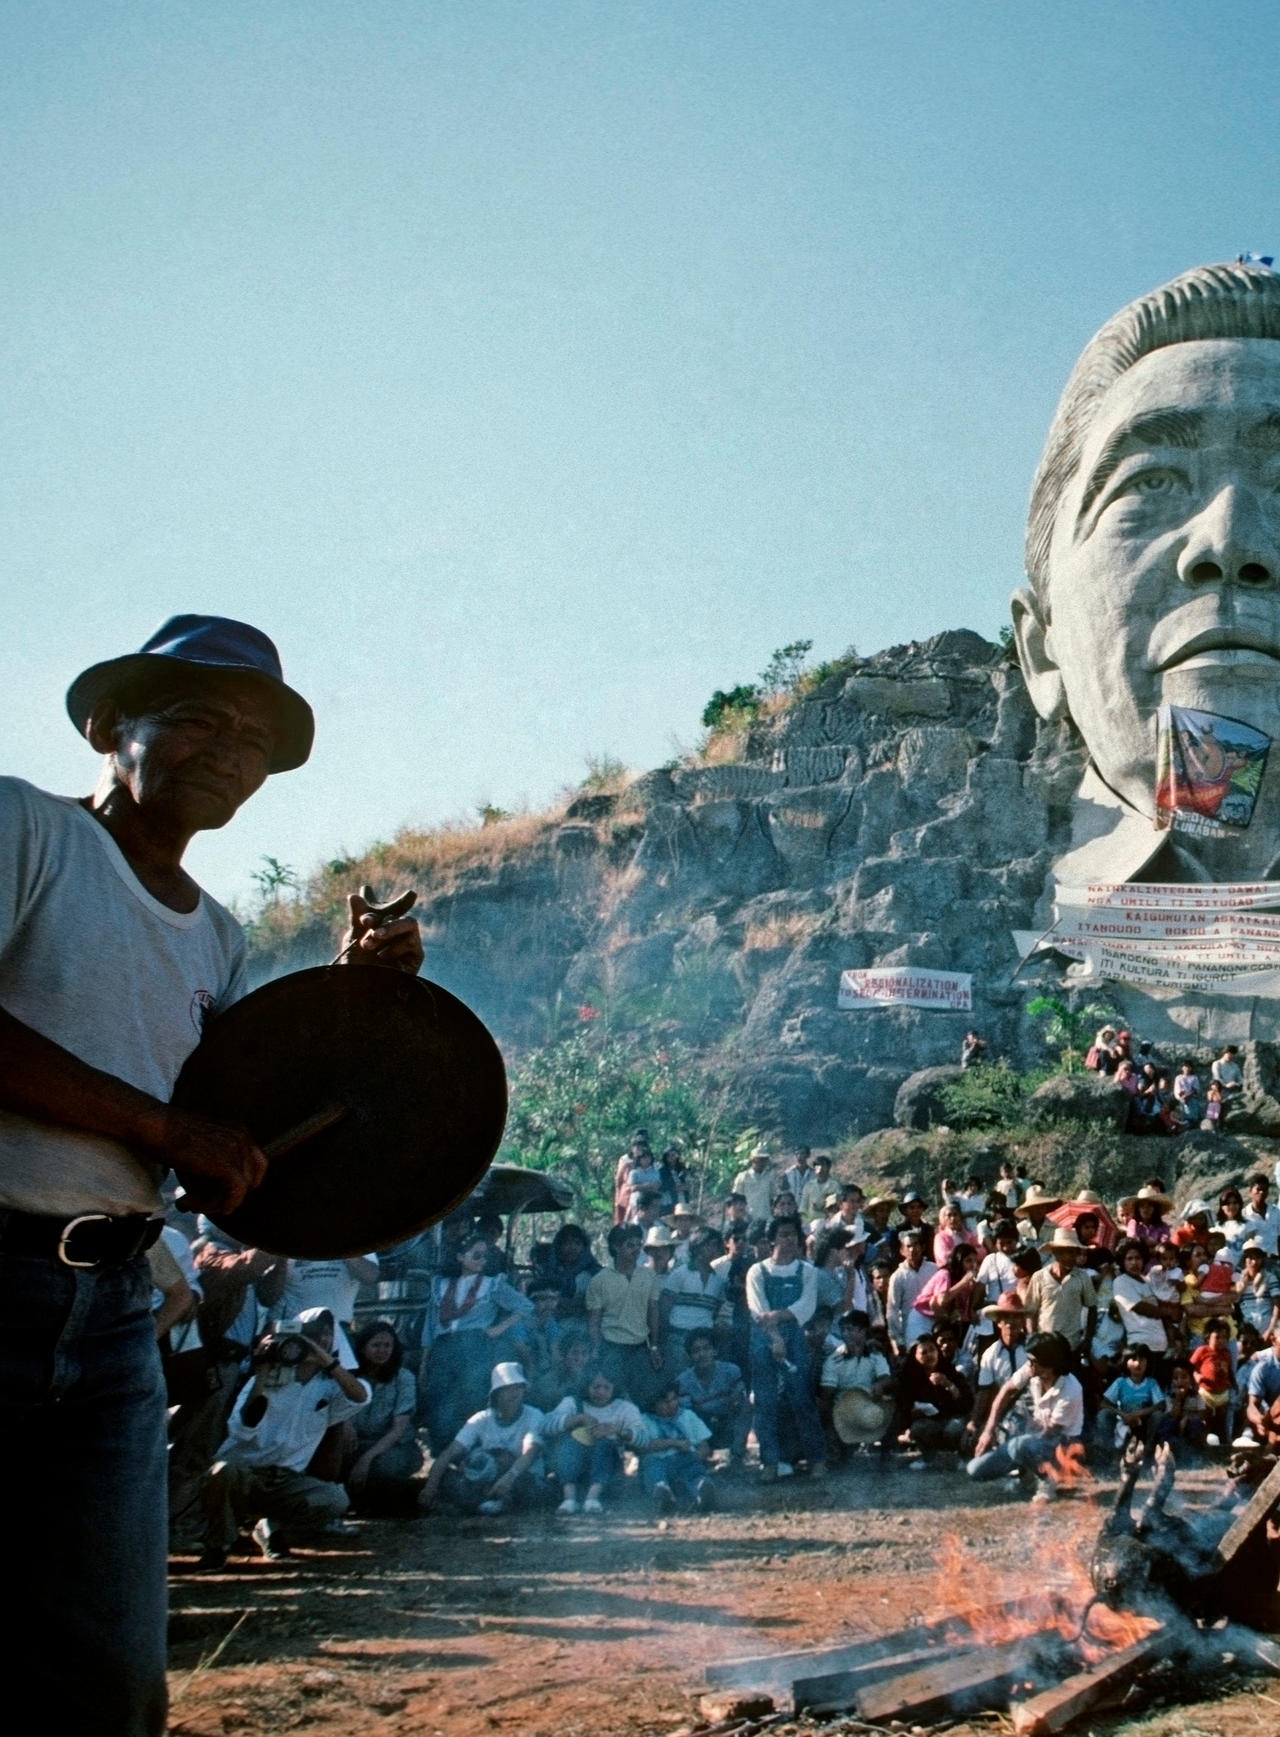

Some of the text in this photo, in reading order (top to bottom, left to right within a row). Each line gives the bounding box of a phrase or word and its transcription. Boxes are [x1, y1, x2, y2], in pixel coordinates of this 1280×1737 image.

[1171, 899, 1183, 908] TI
[1100, 959, 1114, 969] ITI
[1119, 963, 1170, 977] KULTURA
[1177, 972, 1186, 980] TI
[864, 977, 959, 992] REGIONALIZATION
